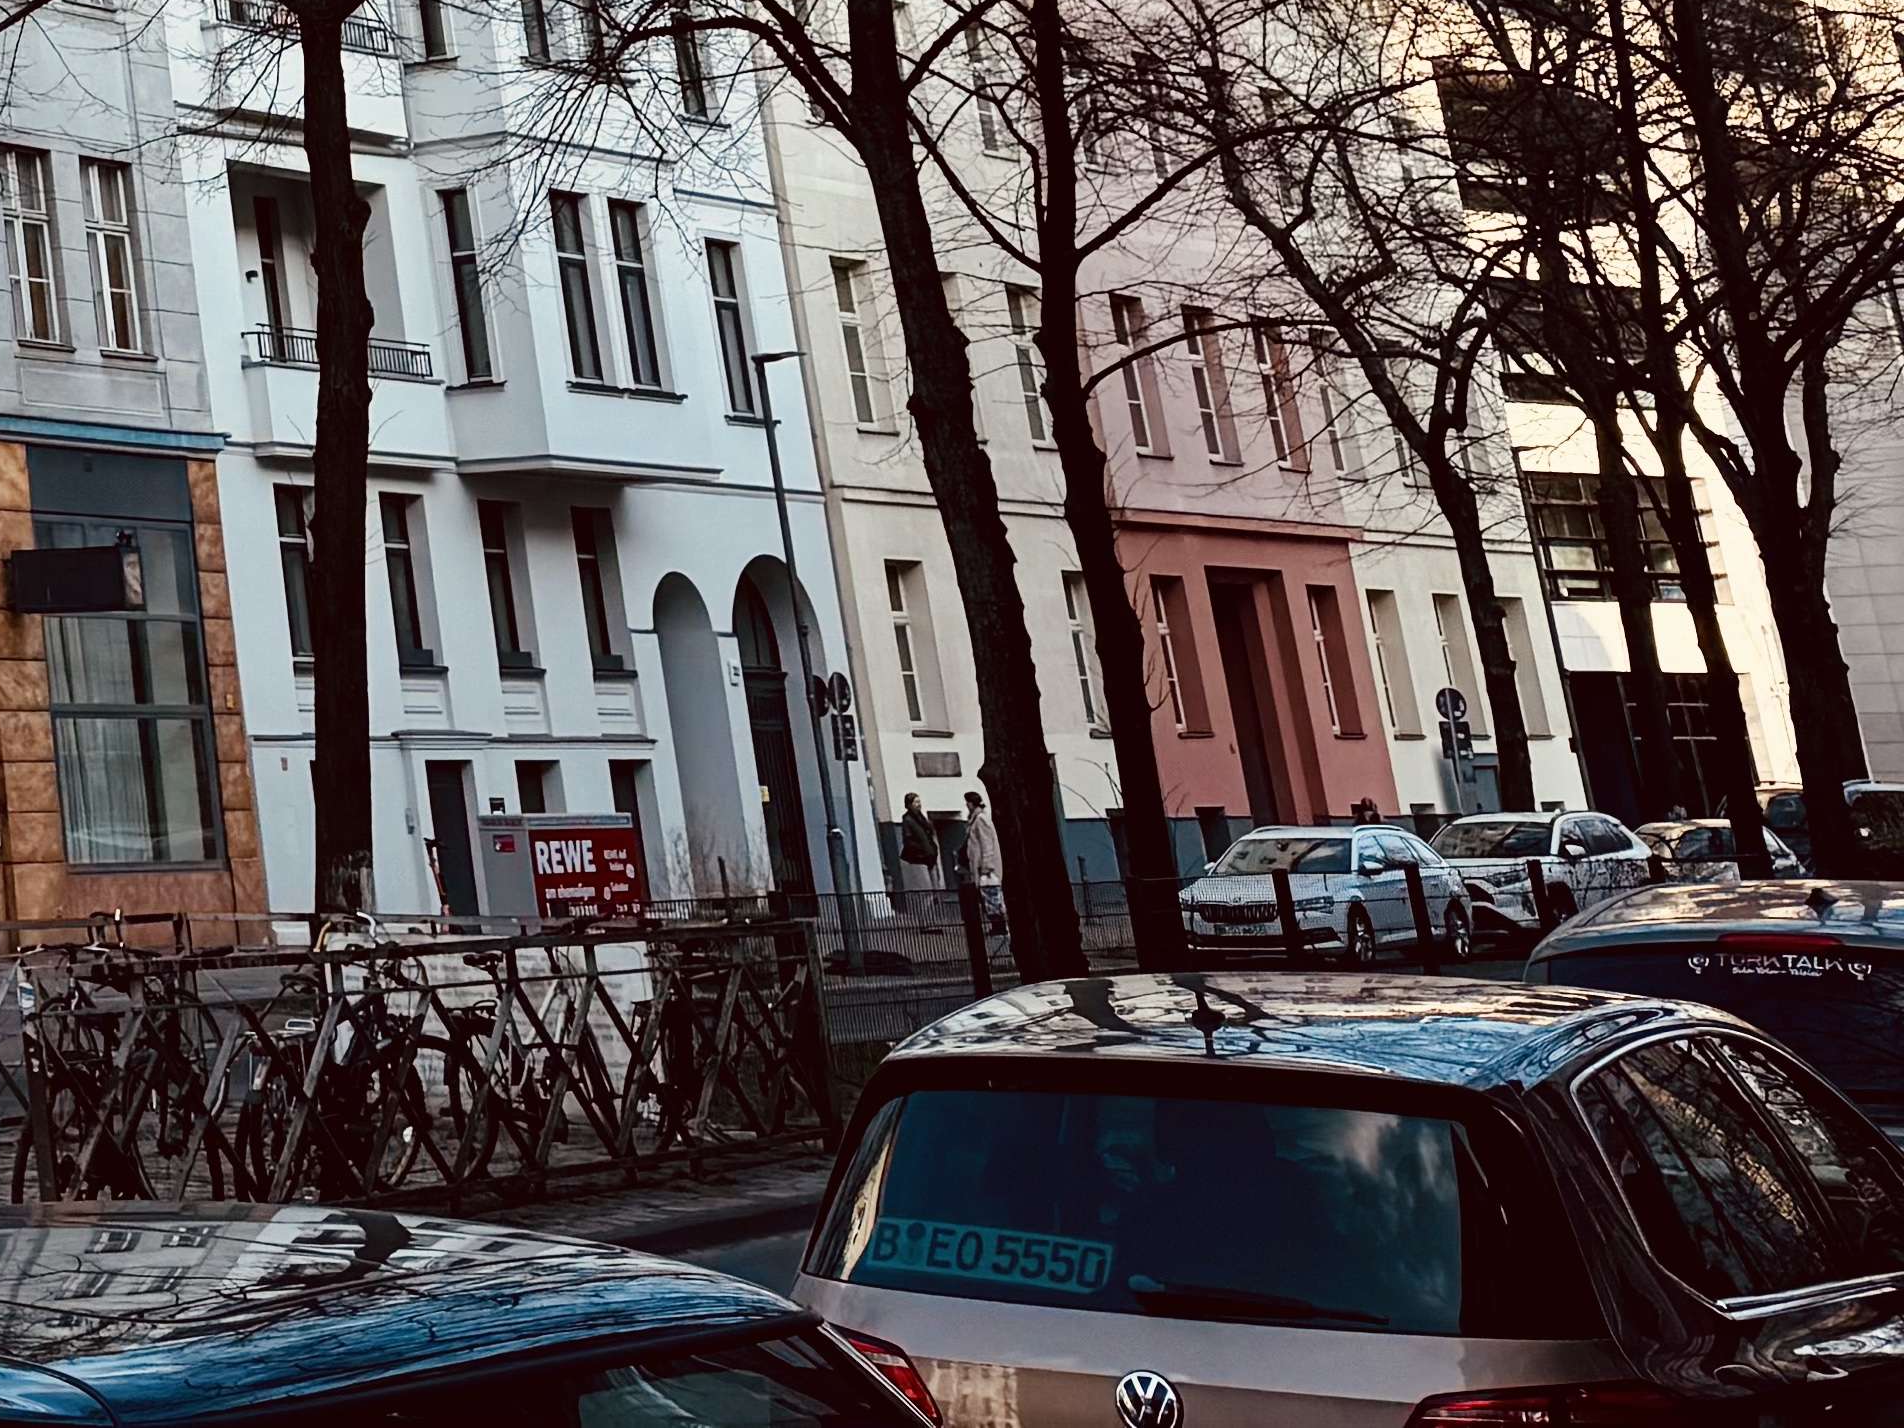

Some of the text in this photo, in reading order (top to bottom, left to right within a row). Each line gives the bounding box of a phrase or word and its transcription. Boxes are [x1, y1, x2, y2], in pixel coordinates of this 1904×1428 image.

[534, 839, 597, 875] REWE
[872, 1222, 900, 1262] B
[991, 1234, 1107, 1289] 5550
